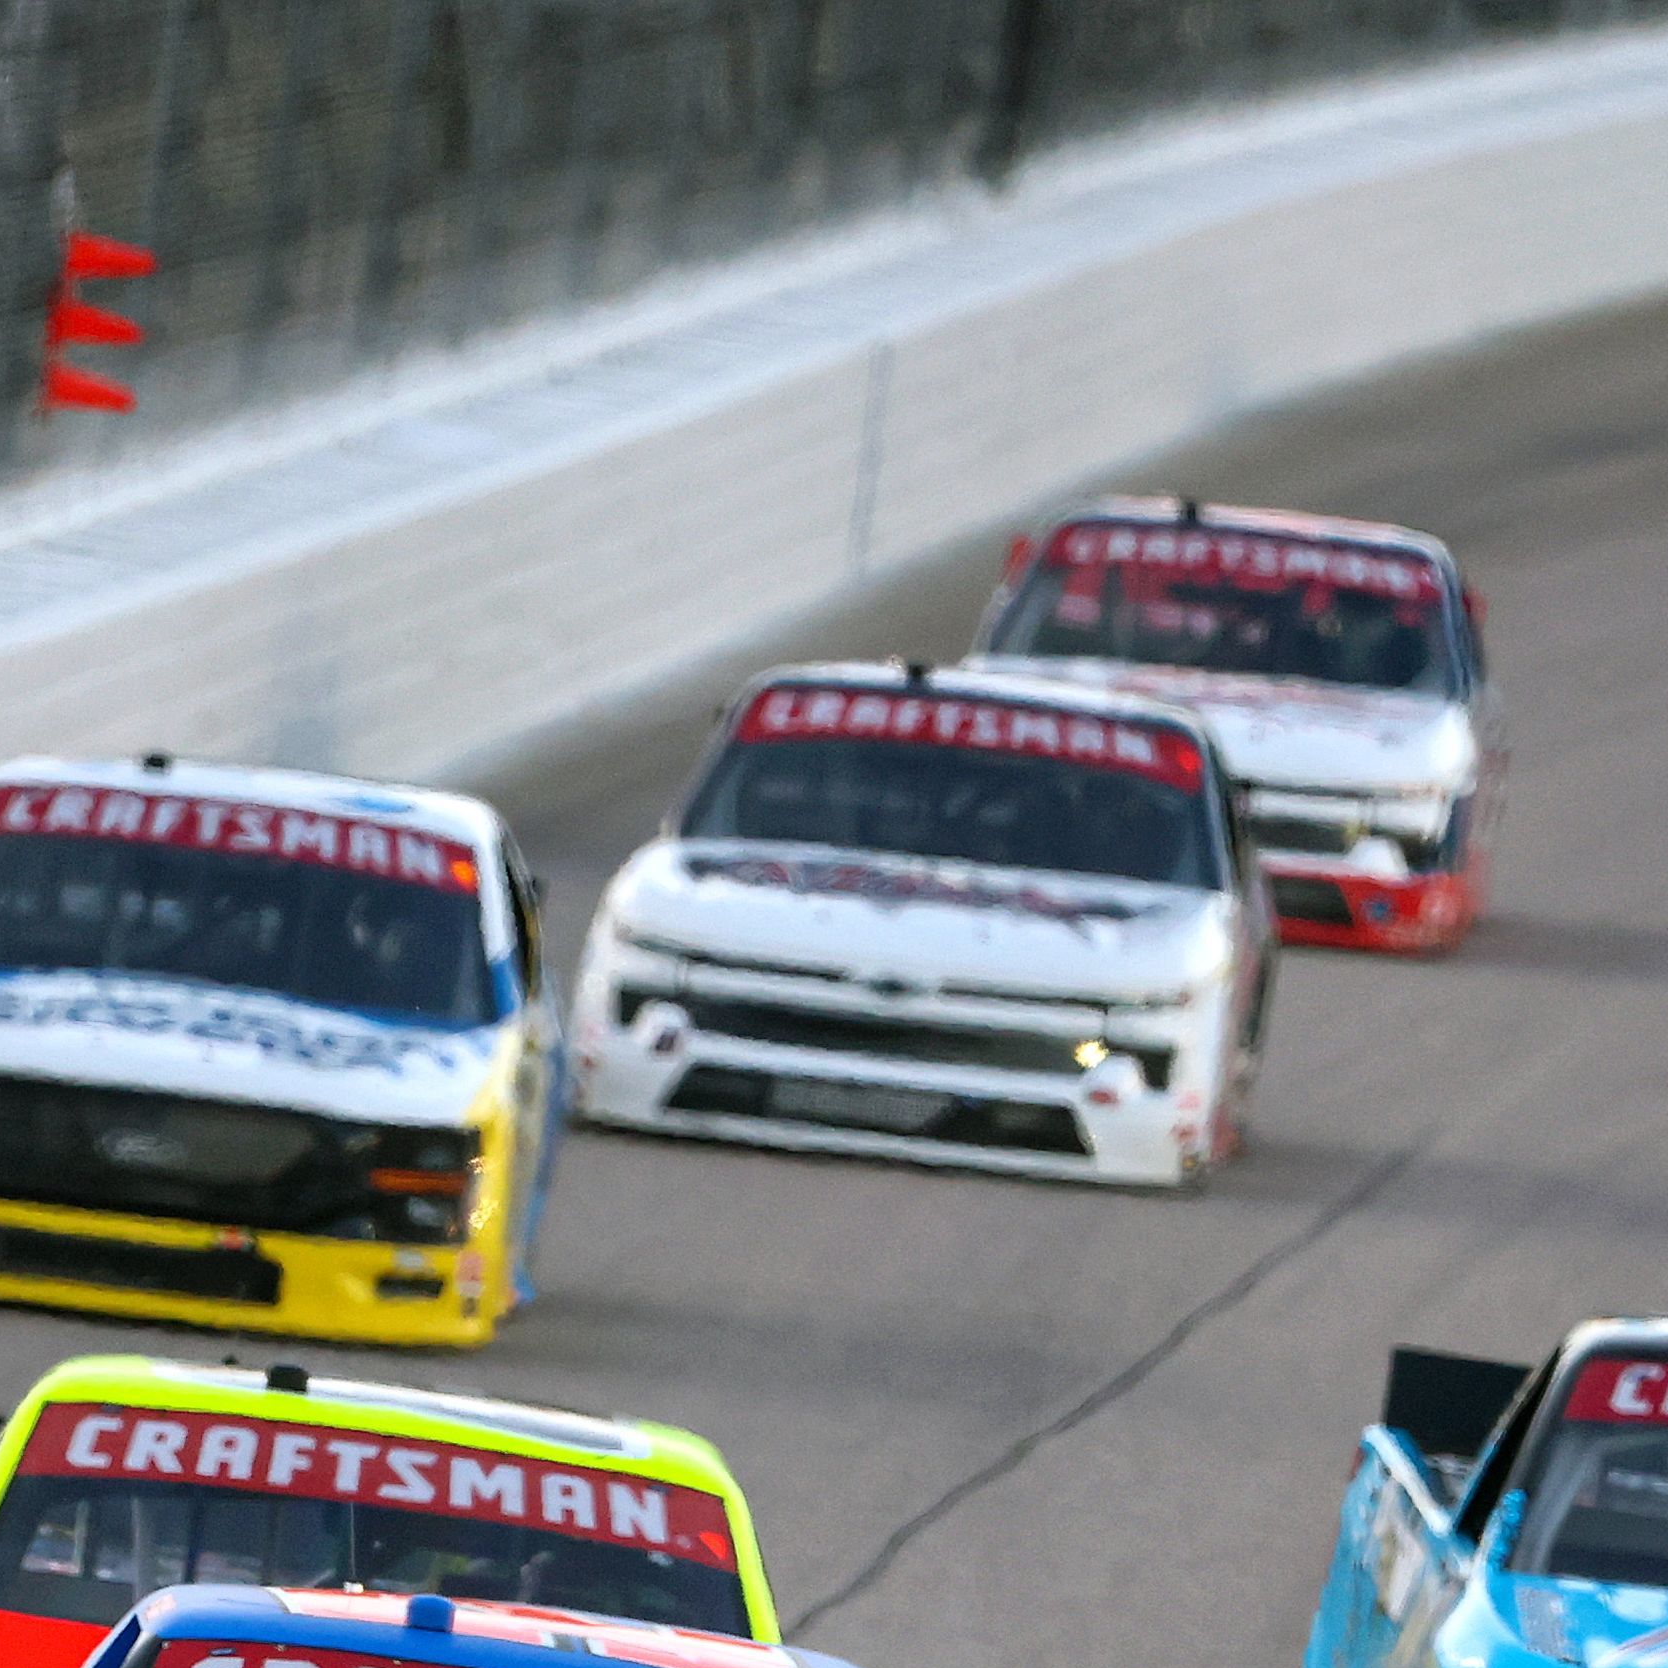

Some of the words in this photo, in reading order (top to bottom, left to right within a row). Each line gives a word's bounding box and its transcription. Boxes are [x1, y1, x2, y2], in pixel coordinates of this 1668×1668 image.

[760, 690, 1156, 766] CRAFTSMAN
[0, 788, 446, 886] CRAFTSMAN
[65, 1413, 669, 1544] CRAFTSMAN
